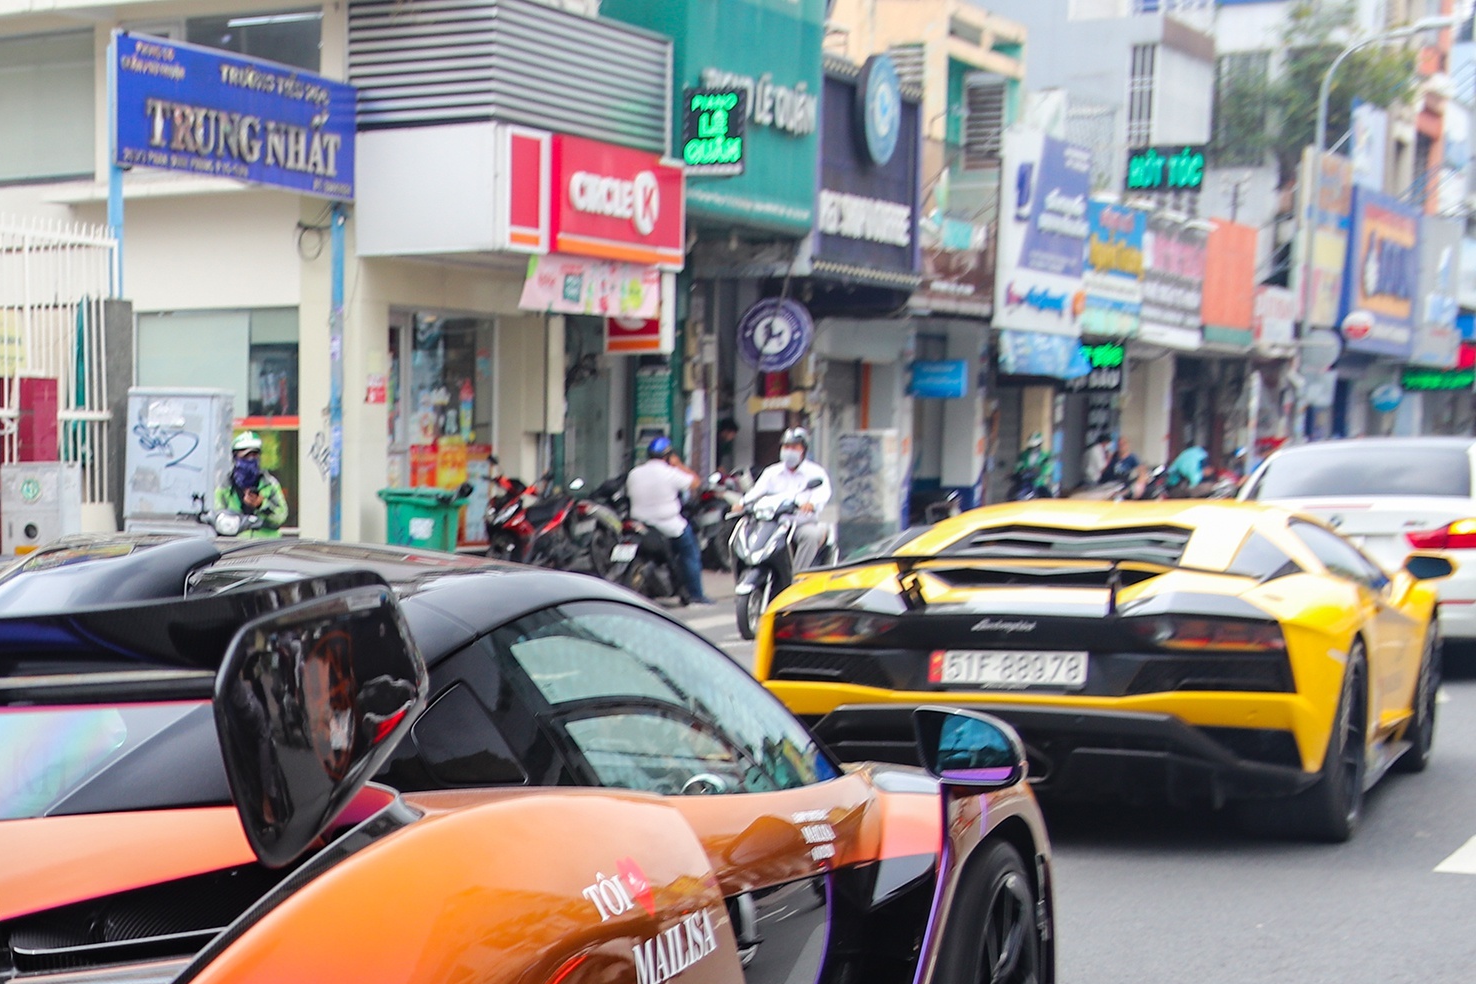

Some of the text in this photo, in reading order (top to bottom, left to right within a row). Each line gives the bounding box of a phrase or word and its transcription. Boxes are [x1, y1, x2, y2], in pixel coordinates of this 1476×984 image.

[146, 97, 263, 164] TRUNG
[265, 110, 341, 177] NHẤT
[569, 171, 633, 219] CIRCLE
[582, 871, 636, 922] TÔI
